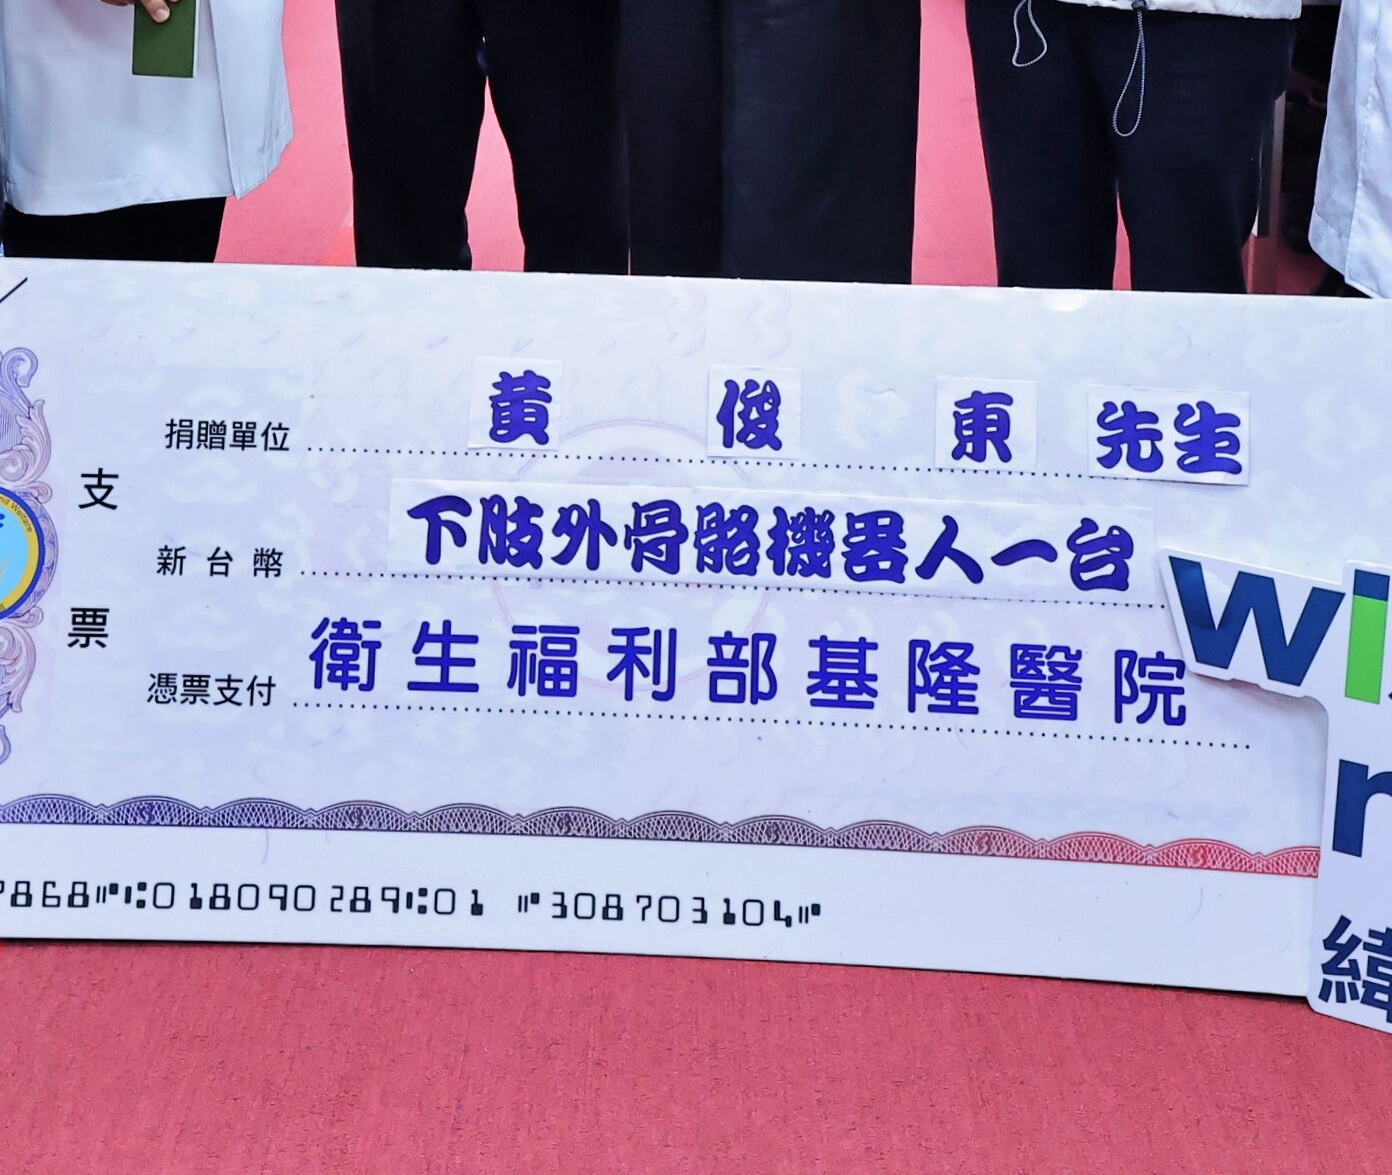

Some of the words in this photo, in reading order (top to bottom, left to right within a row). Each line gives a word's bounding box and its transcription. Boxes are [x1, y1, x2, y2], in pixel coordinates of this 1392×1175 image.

[165, 418, 290, 452] 捐贈單位
[156, 545, 284, 579] 新台幣
[408, 494, 1135, 592] 下肢外骨骼機器人一台
[147, 672, 277, 707] 憑票支付
[309, 616, 1187, 727] 衛生福利部基隆醫院
